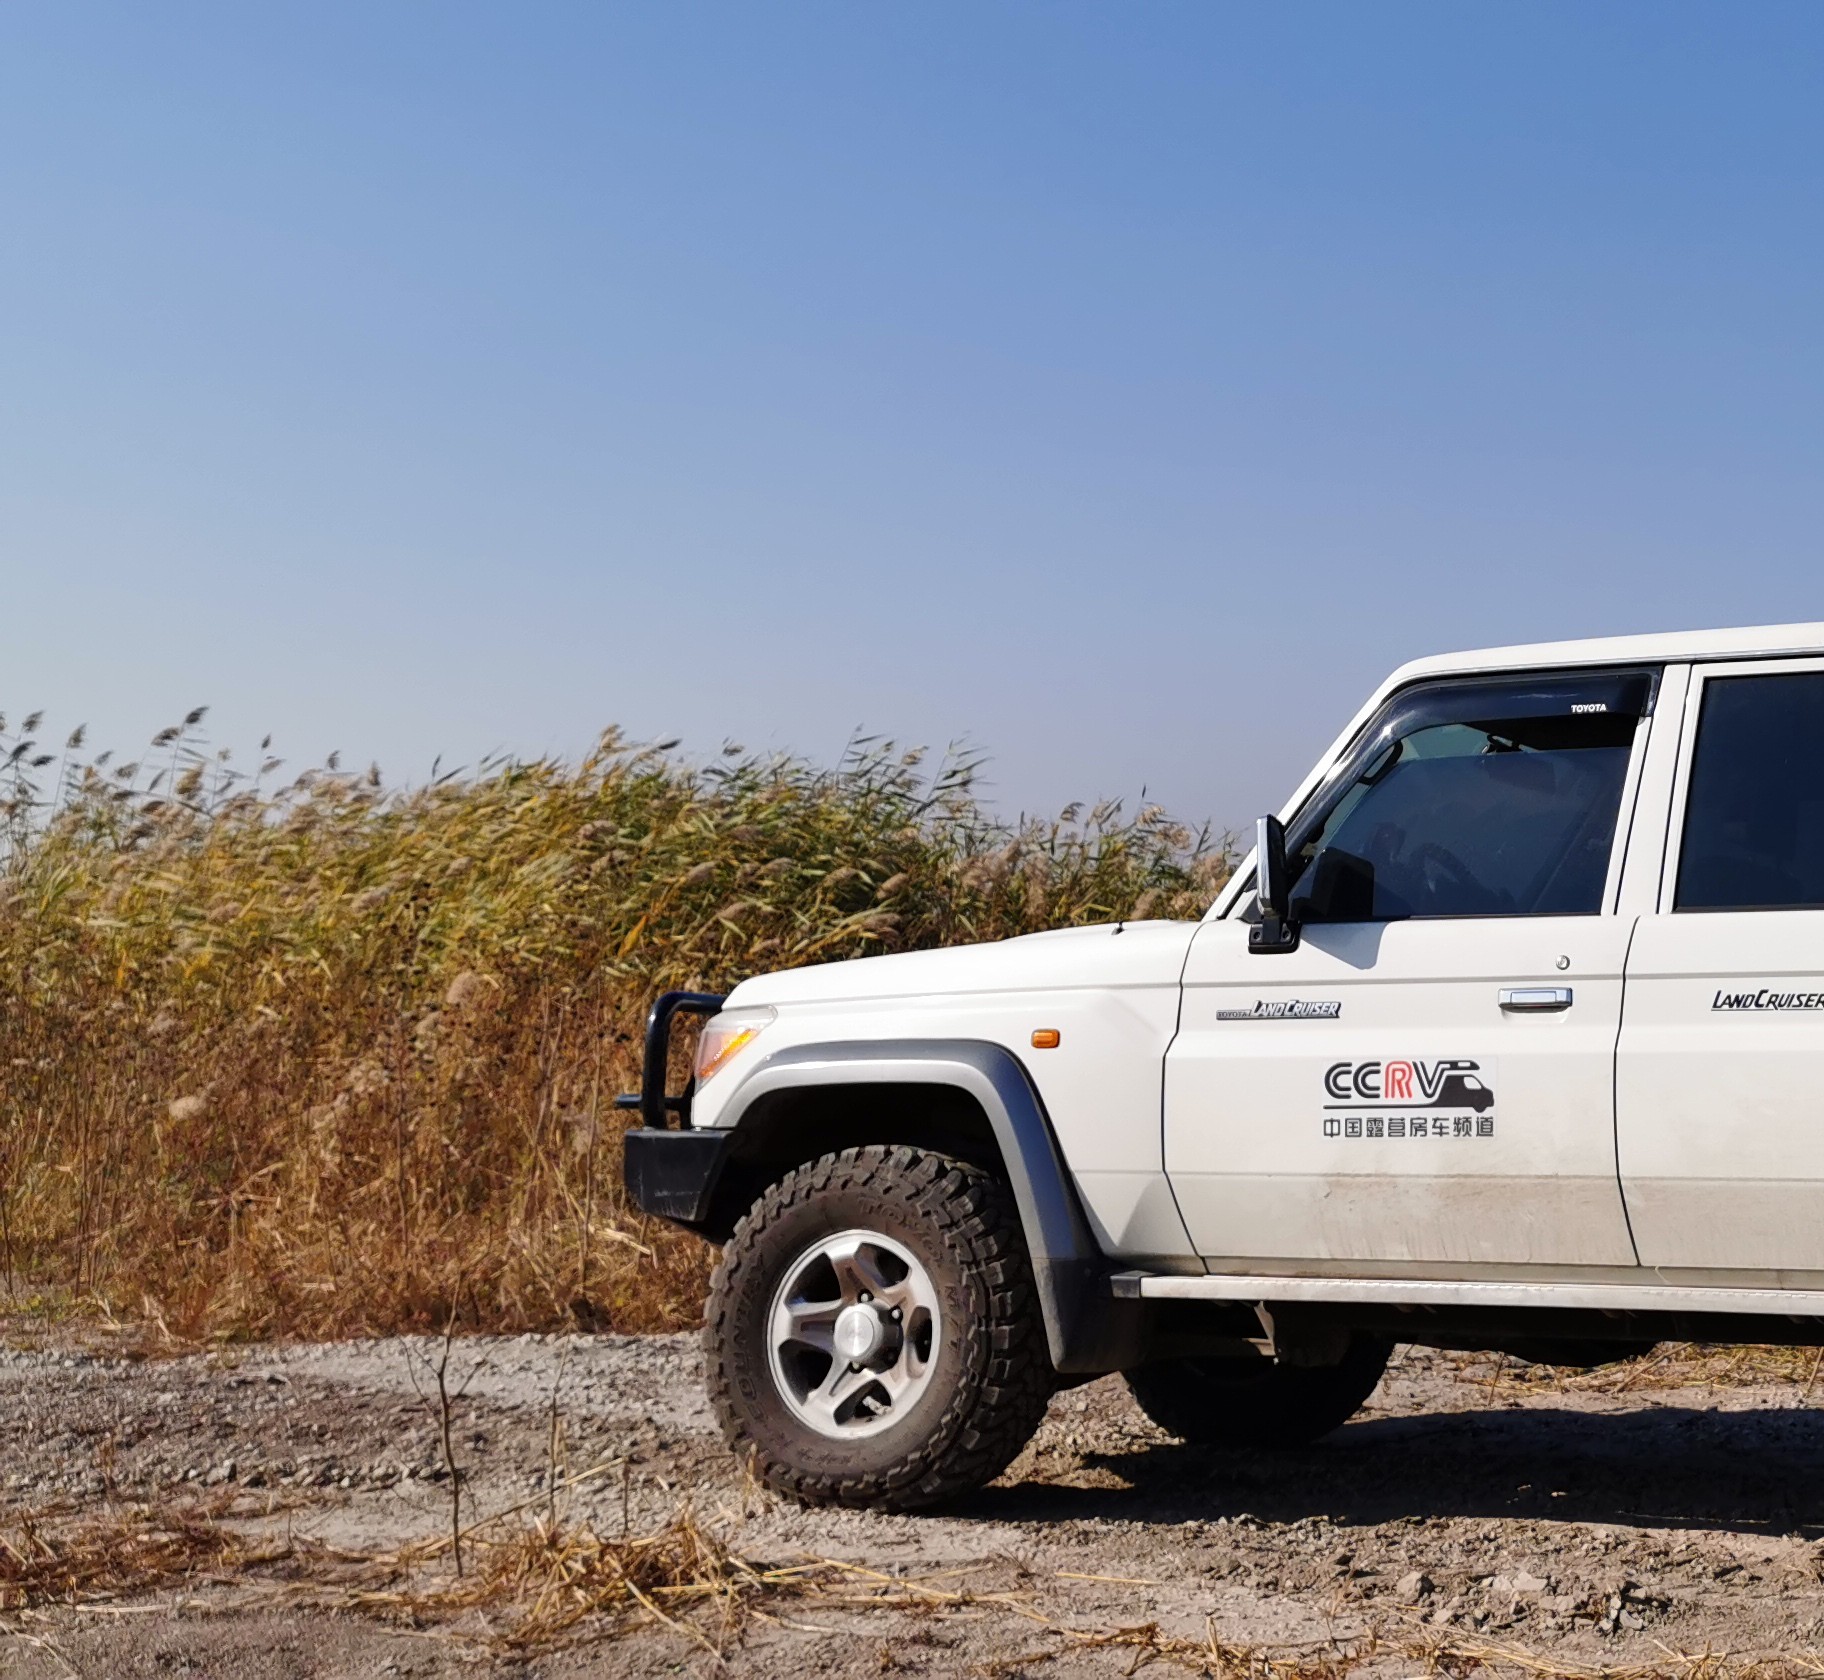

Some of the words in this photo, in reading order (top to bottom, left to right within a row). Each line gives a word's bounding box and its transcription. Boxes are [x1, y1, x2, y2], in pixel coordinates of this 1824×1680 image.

[1571, 703, 1607, 713] TOYOTA
[1324, 1060, 1450, 1099] CCRV
[1323, 1117, 1494, 1138] 中国露营房车频道
